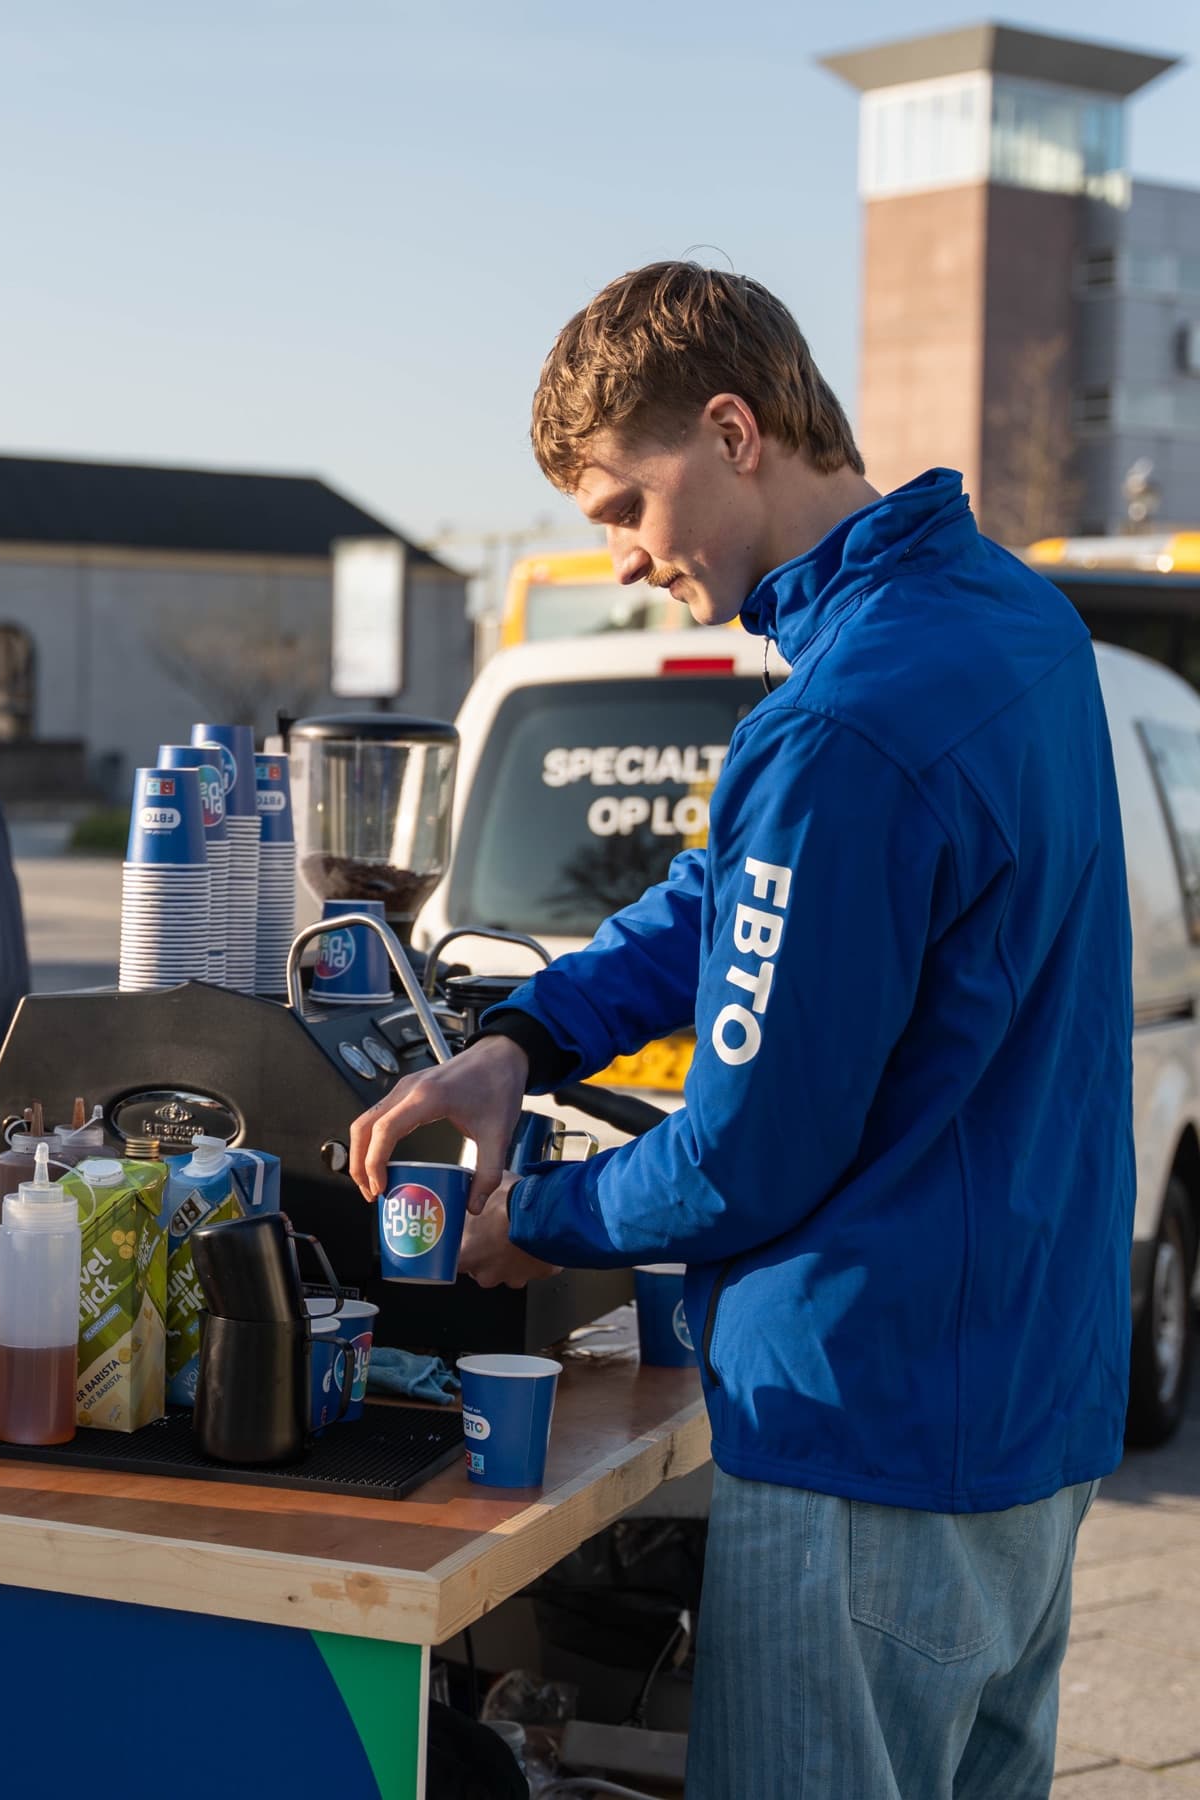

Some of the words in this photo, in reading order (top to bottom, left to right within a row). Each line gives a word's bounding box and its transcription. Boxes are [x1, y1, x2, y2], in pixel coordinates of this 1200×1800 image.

[587, 796, 650, 836] OP
[652, 796, 710, 835] LO
[318, 949, 346, 968] Plu
[712, 856, 793, 1066] FBTO
[388, 1197, 439, 1221] Pluk
[83, 1395, 97, 1410] OAT
[95, 1373, 122, 1399] BARISTA
[84, 1359, 121, 1393] BARISTA
